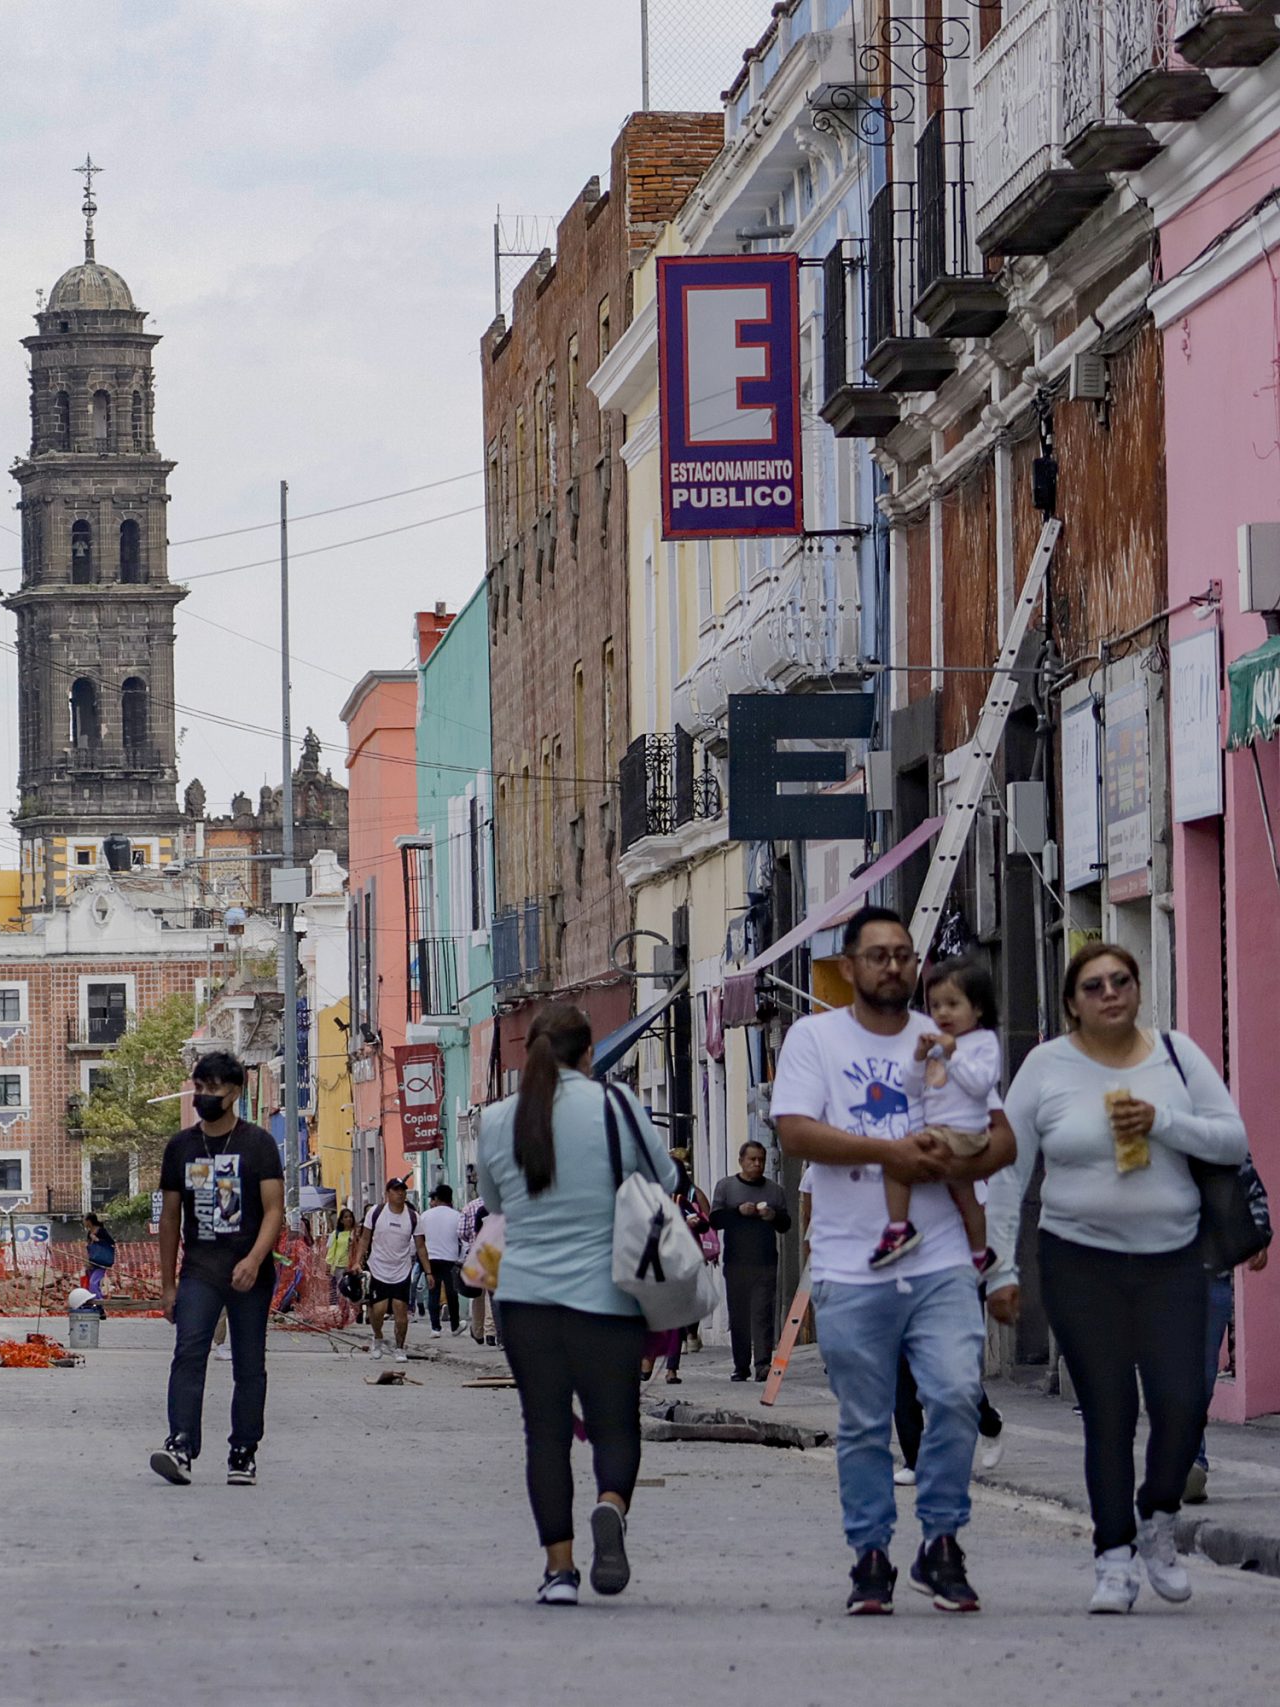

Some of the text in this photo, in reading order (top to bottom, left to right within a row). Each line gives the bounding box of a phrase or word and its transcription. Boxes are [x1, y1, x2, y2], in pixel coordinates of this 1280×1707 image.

[682, 284, 776, 446] E
[671, 460, 792, 482] ESTACIONAMIENTO
[673, 486, 792, 508] PUBLICO
[404, 1112, 438, 1125] Copias
[415, 1127, 437, 1138] Sarc
